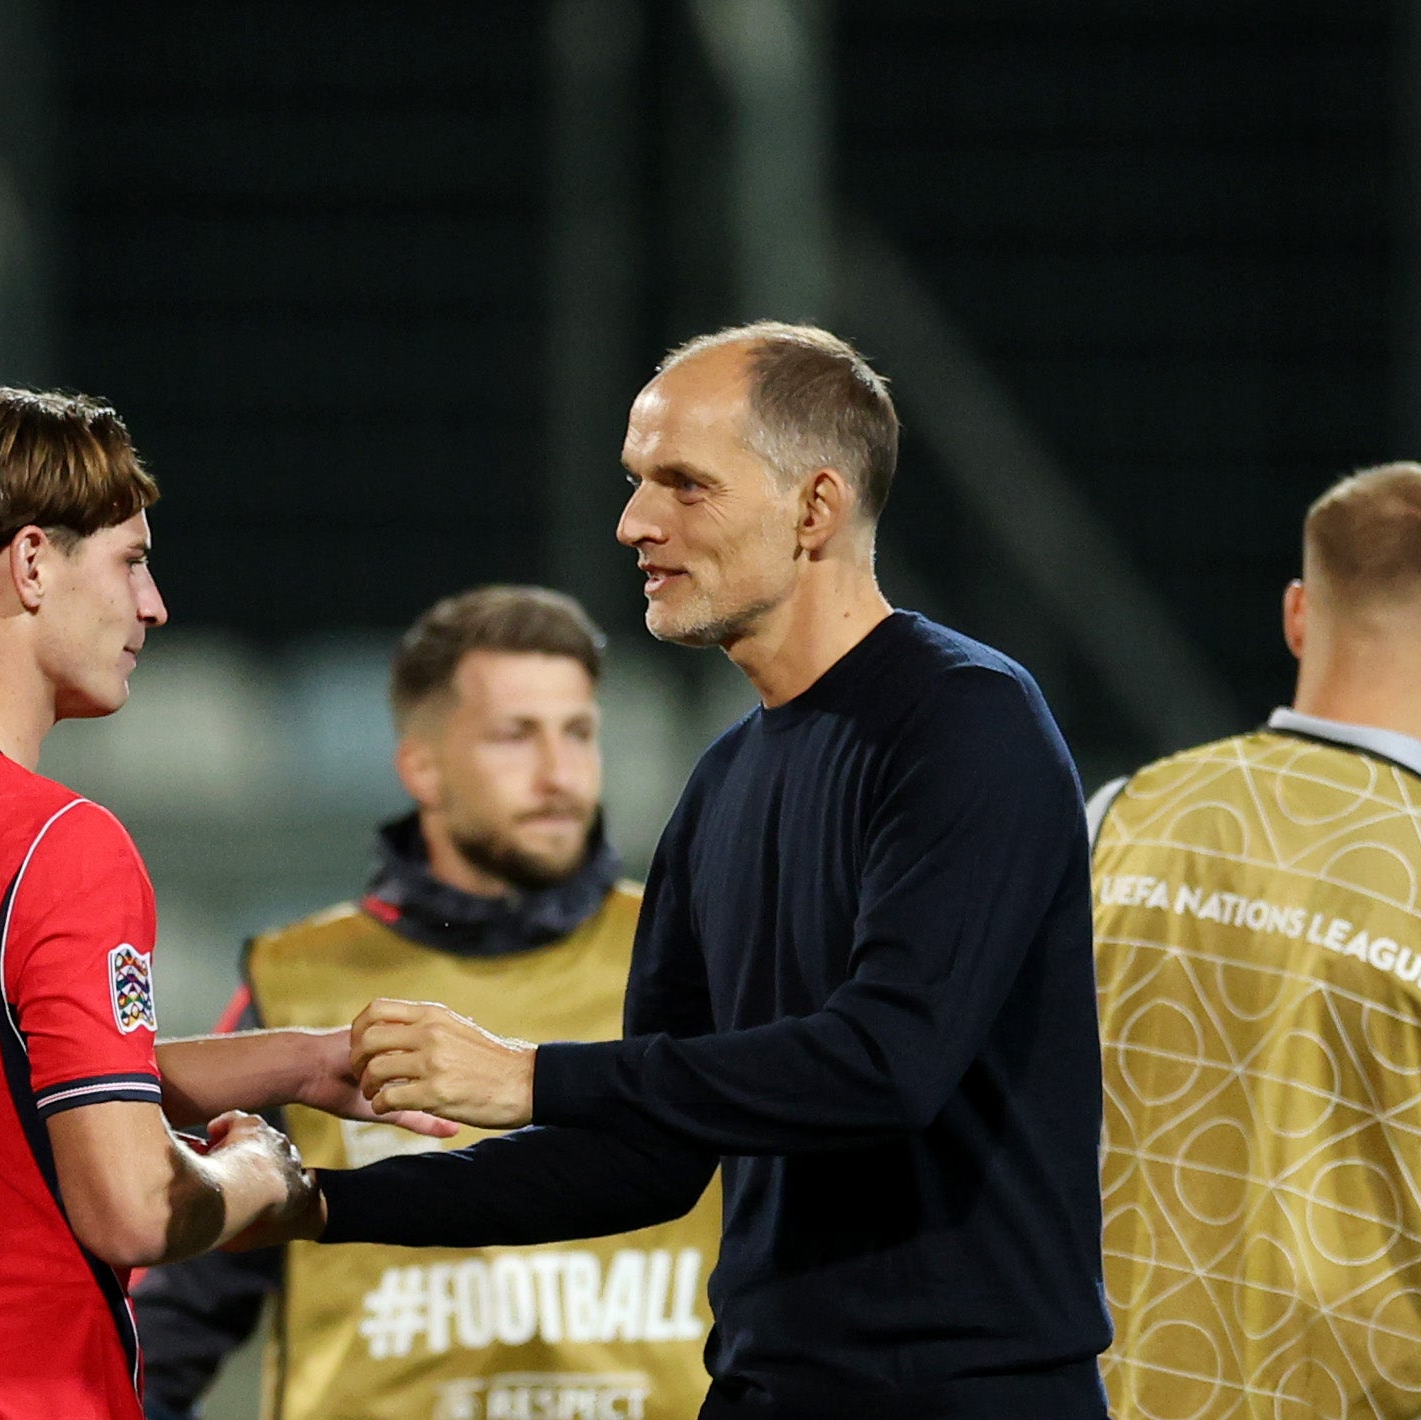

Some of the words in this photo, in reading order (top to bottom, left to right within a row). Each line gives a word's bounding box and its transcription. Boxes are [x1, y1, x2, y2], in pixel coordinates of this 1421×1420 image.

[1099, 874, 1170, 910] UEFA
[1173, 886, 1306, 939] NATIONS
[359, 1248, 705, 1360] #FOOTBALL
